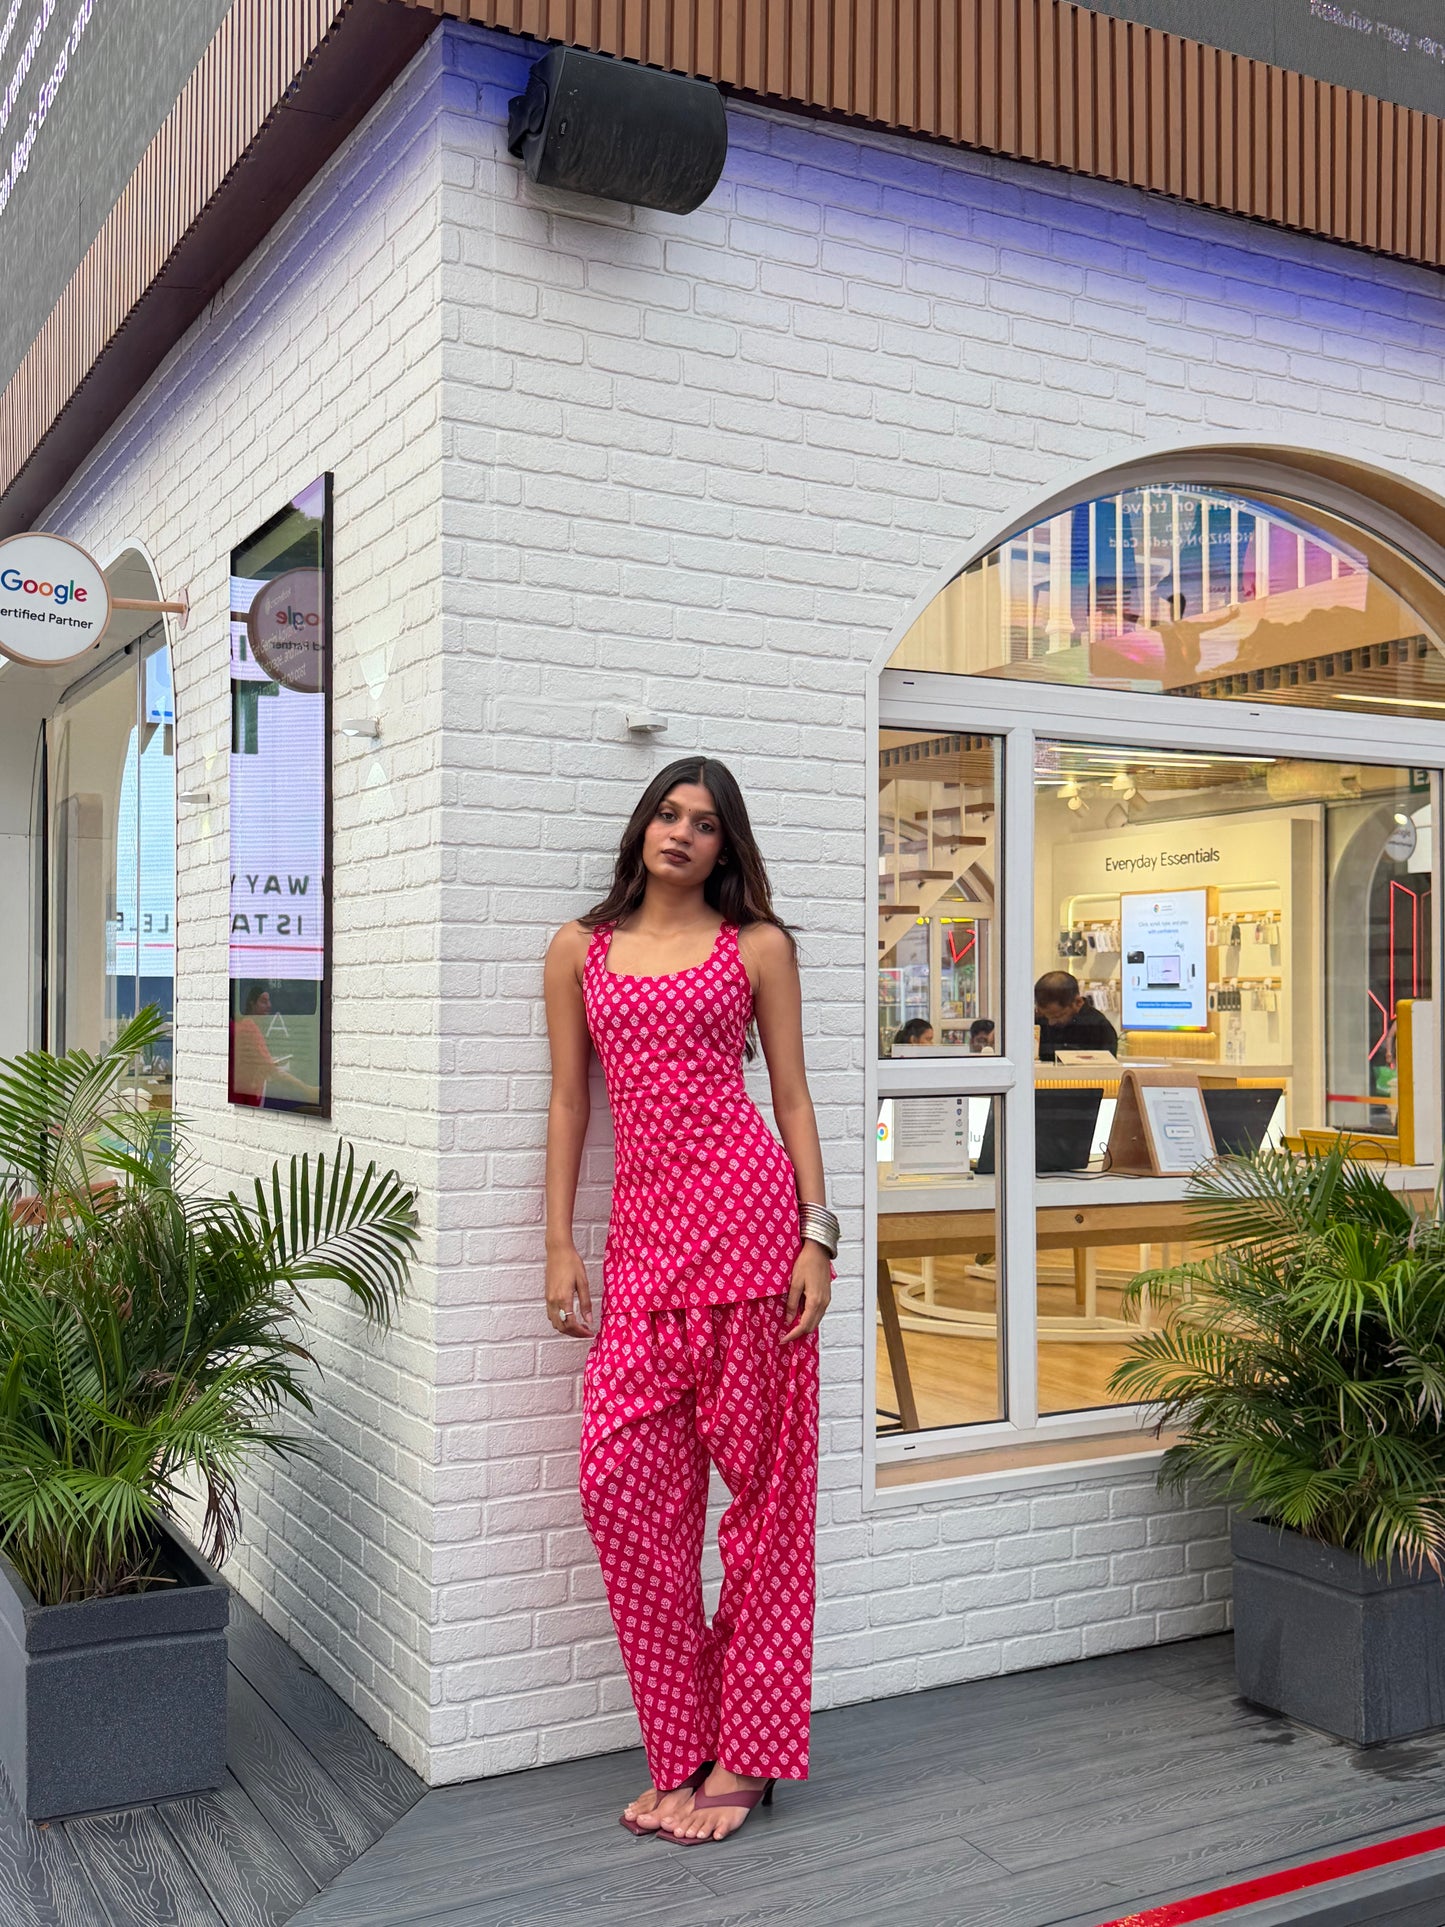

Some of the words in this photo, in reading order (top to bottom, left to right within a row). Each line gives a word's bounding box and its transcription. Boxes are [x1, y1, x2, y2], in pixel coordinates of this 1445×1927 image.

[9, 16, 42, 112] remove
[11, 112, 37, 190] Magic
[39, 36, 71, 130] Eraser
[0, 569, 88, 605] Google
[0, 608, 46, 622] ertified
[48, 613, 94, 629] Partner
[1105, 854, 1158, 873] Everyday
[1160, 847, 1220, 867] Essentials
